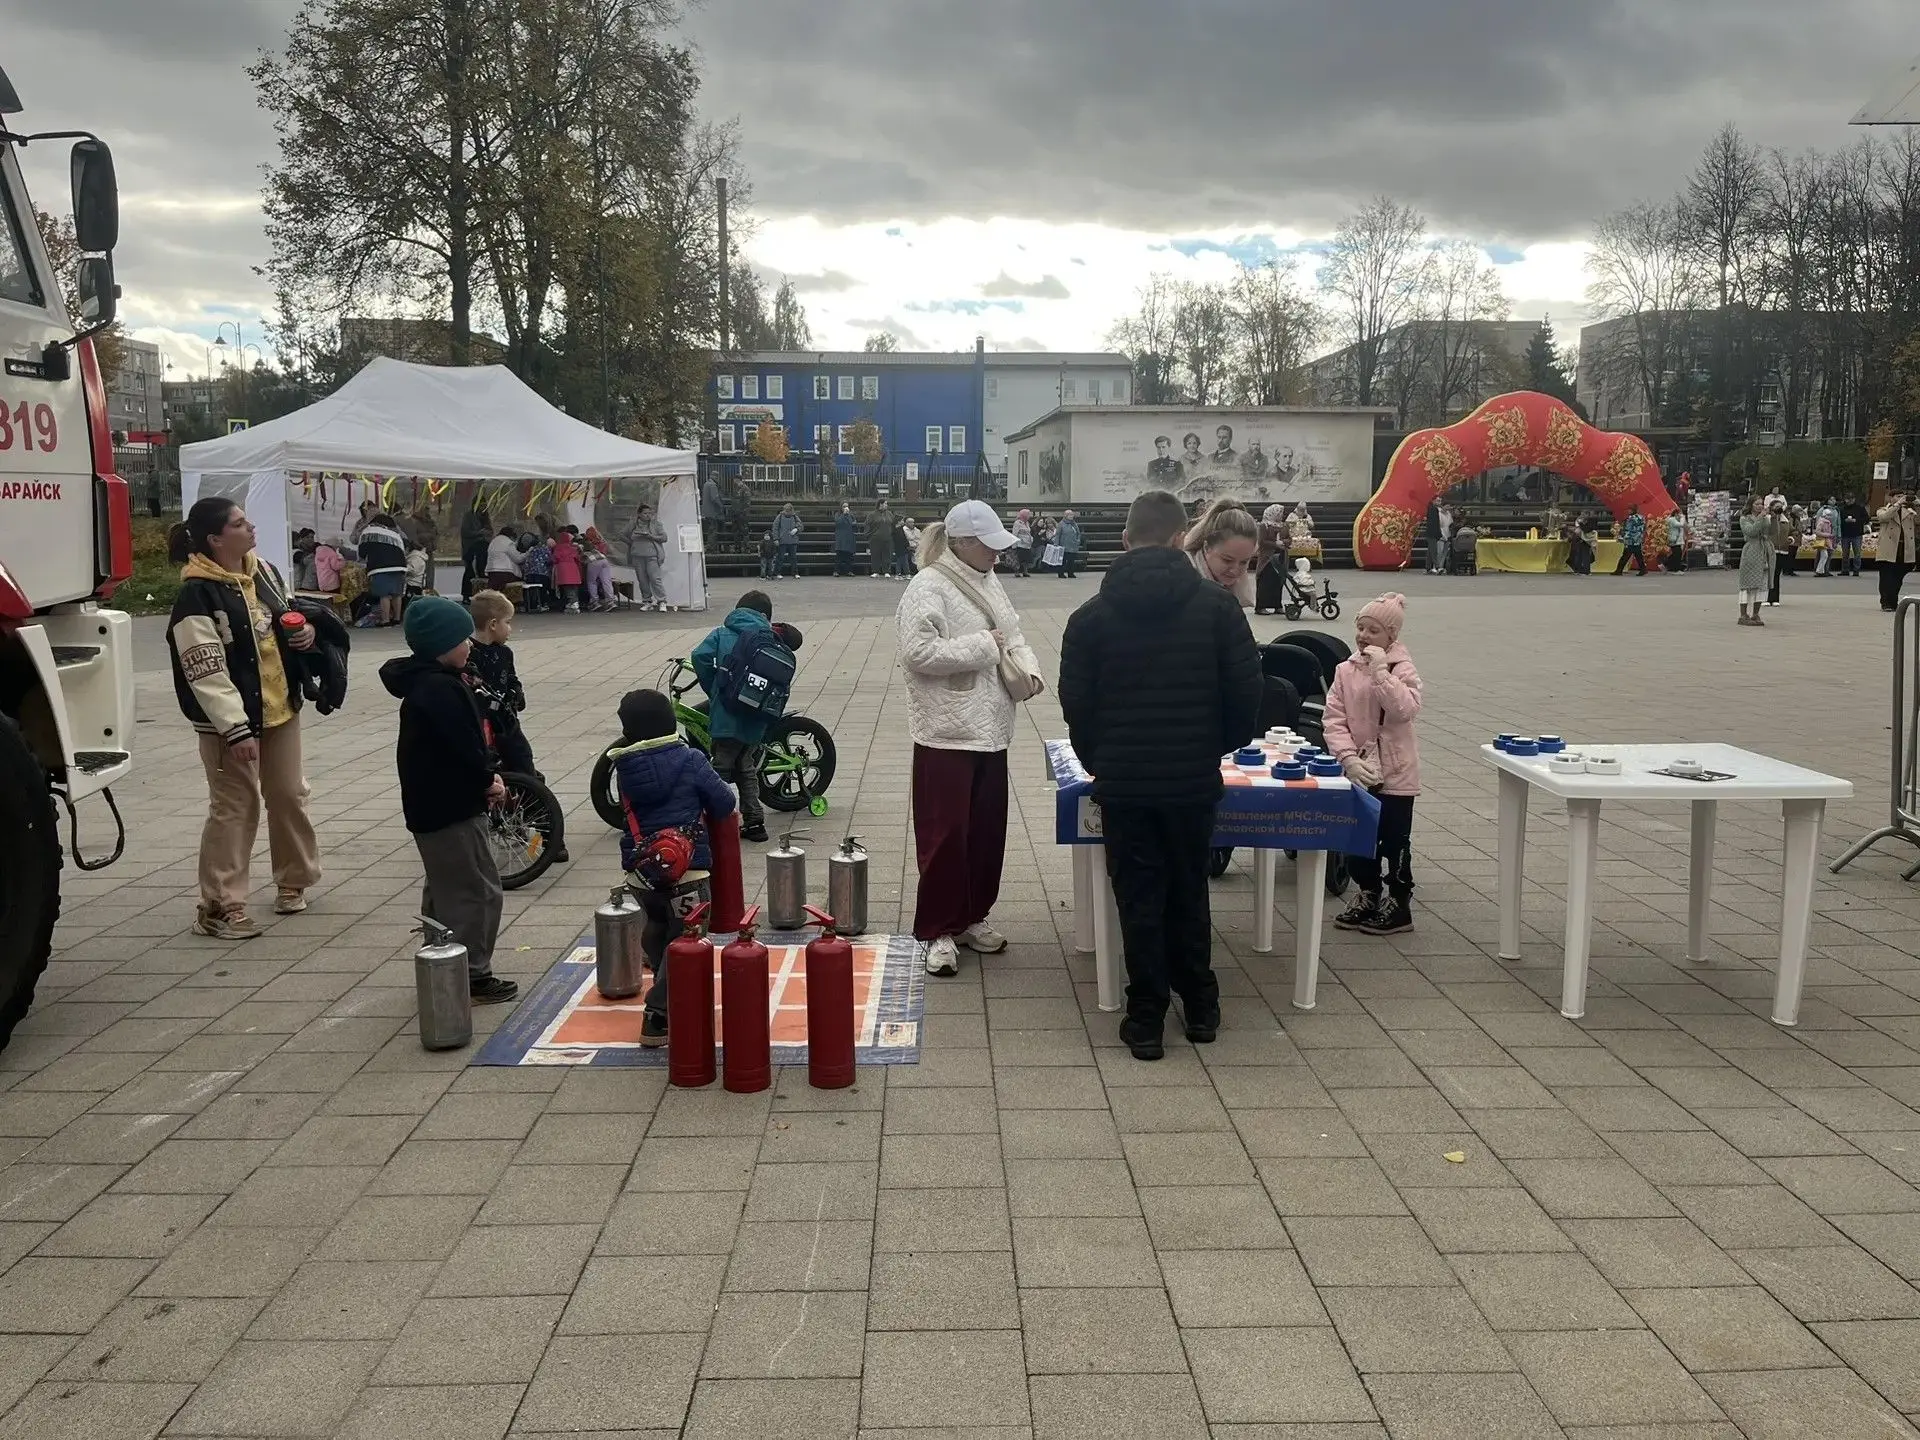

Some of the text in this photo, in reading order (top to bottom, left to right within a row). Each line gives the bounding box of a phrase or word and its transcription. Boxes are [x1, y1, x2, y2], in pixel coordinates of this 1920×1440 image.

[0, 479, 61, 500] АРАЙСК
[1214, 811, 1279, 823] правление
[1283, 810, 1310, 822] МЧС
[1212, 823, 1274, 834] осковской
[677, 896, 694, 917] 5
